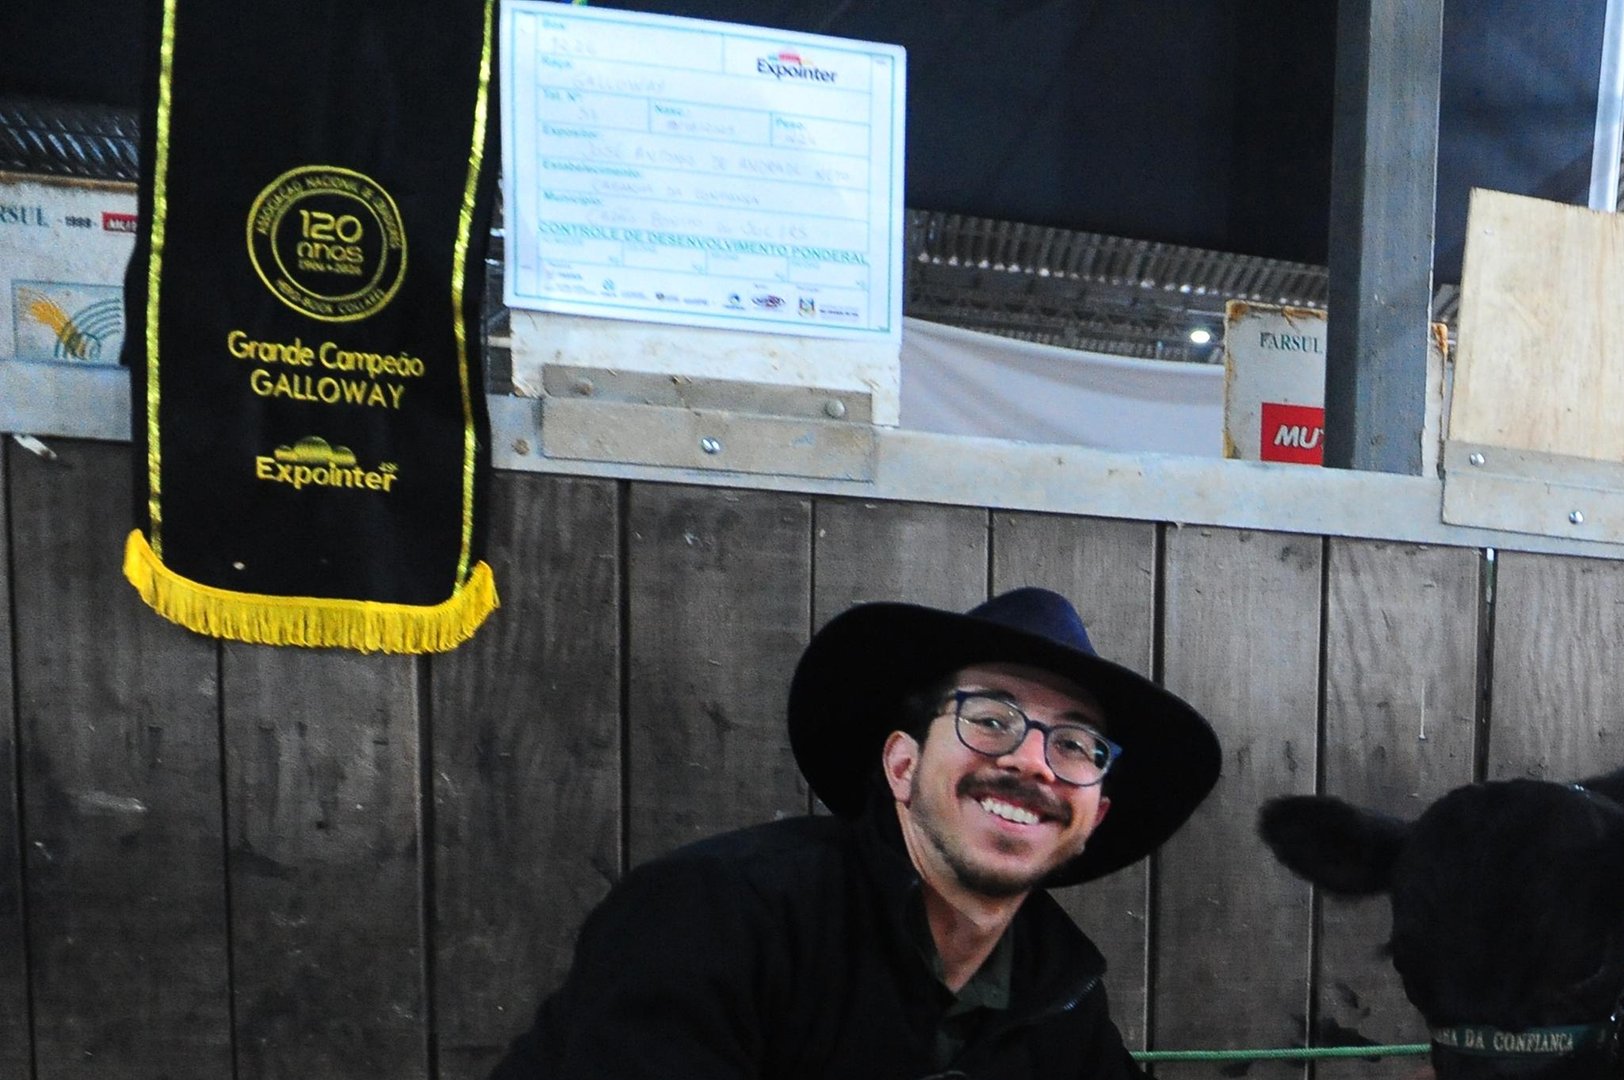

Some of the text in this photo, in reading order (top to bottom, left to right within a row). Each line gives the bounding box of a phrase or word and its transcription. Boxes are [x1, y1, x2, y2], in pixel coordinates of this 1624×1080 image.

[756, 57, 838, 82] Expointer
[299, 209, 363, 244] 120
[296, 241, 364, 263] anos
[539, 219, 621, 242] CONTROLE
[623, 228, 641, 242] DE
[647, 231, 788, 256] DESENVOLVIMENTO
[791, 246, 872, 267] PONDERAL
[227, 330, 425, 378] Grande Campeão
[1260, 332, 1323, 354] FARSUL
[250, 369, 405, 410] GALLOWAY
[1274, 425, 1325, 449] MU
[255, 455, 398, 493] Expointer
[1465, 1029, 1485, 1050] DA
